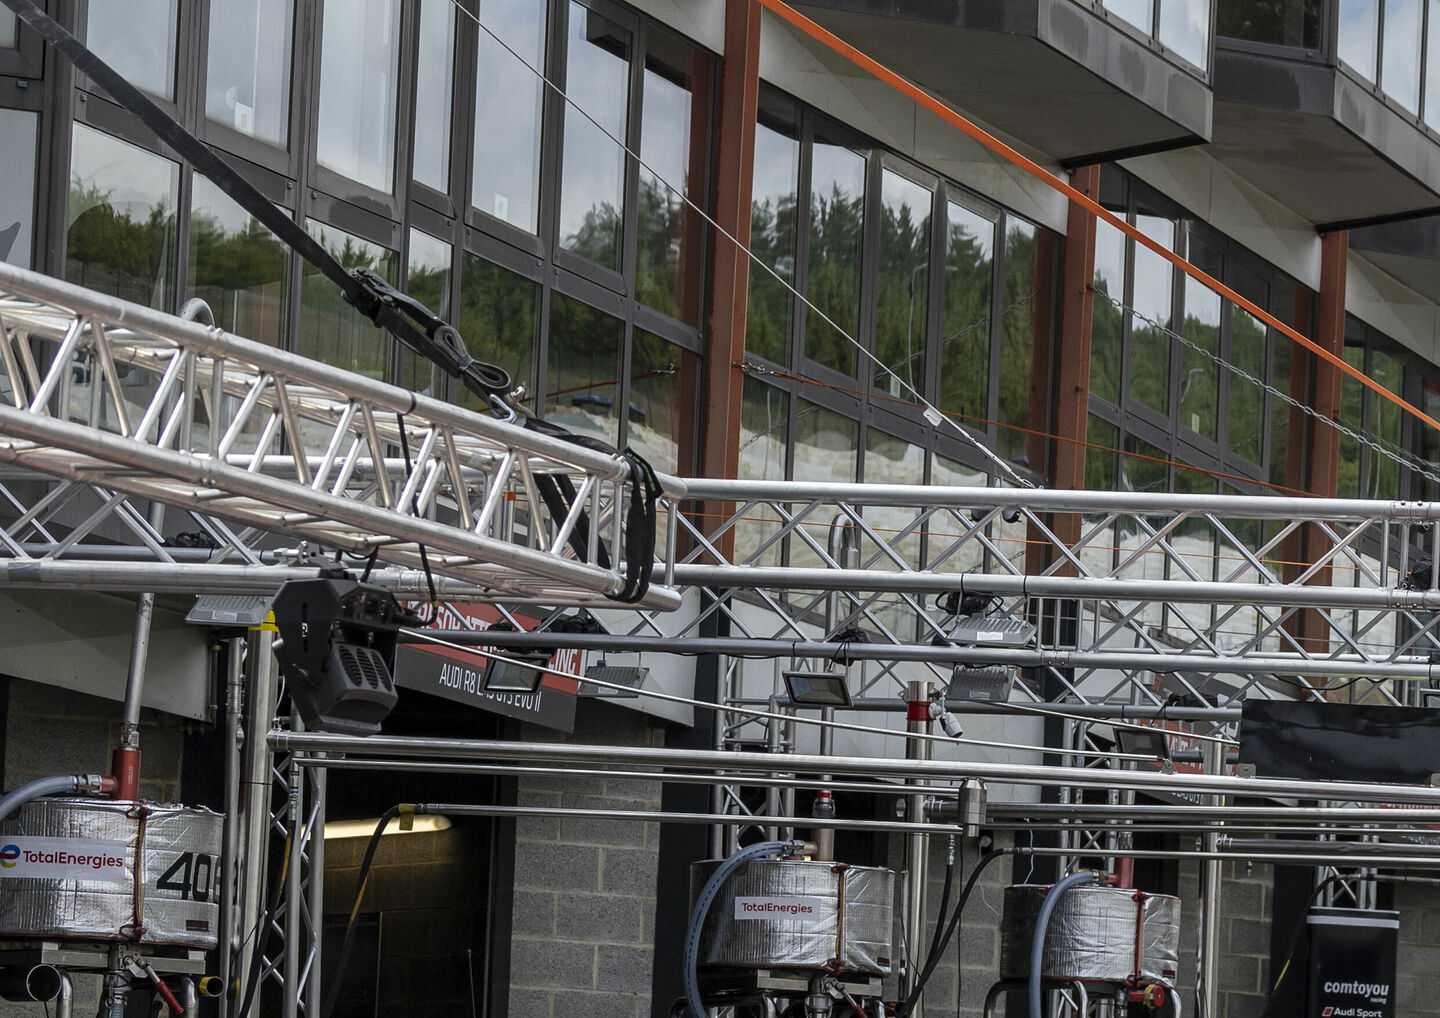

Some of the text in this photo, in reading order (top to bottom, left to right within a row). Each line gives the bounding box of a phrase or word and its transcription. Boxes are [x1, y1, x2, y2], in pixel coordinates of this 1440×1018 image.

[439, 663, 463, 690] AUDI
[464, 667, 477, 694] R8
[23, 850, 123, 869] TotalEnergies
[742, 902, 813, 915] TotalEnergies
[1324, 981, 1389, 998] comtoyou
[1370, 997, 1387, 1005] racing
[1334, 1007, 1382, 1018] Audi Sport
